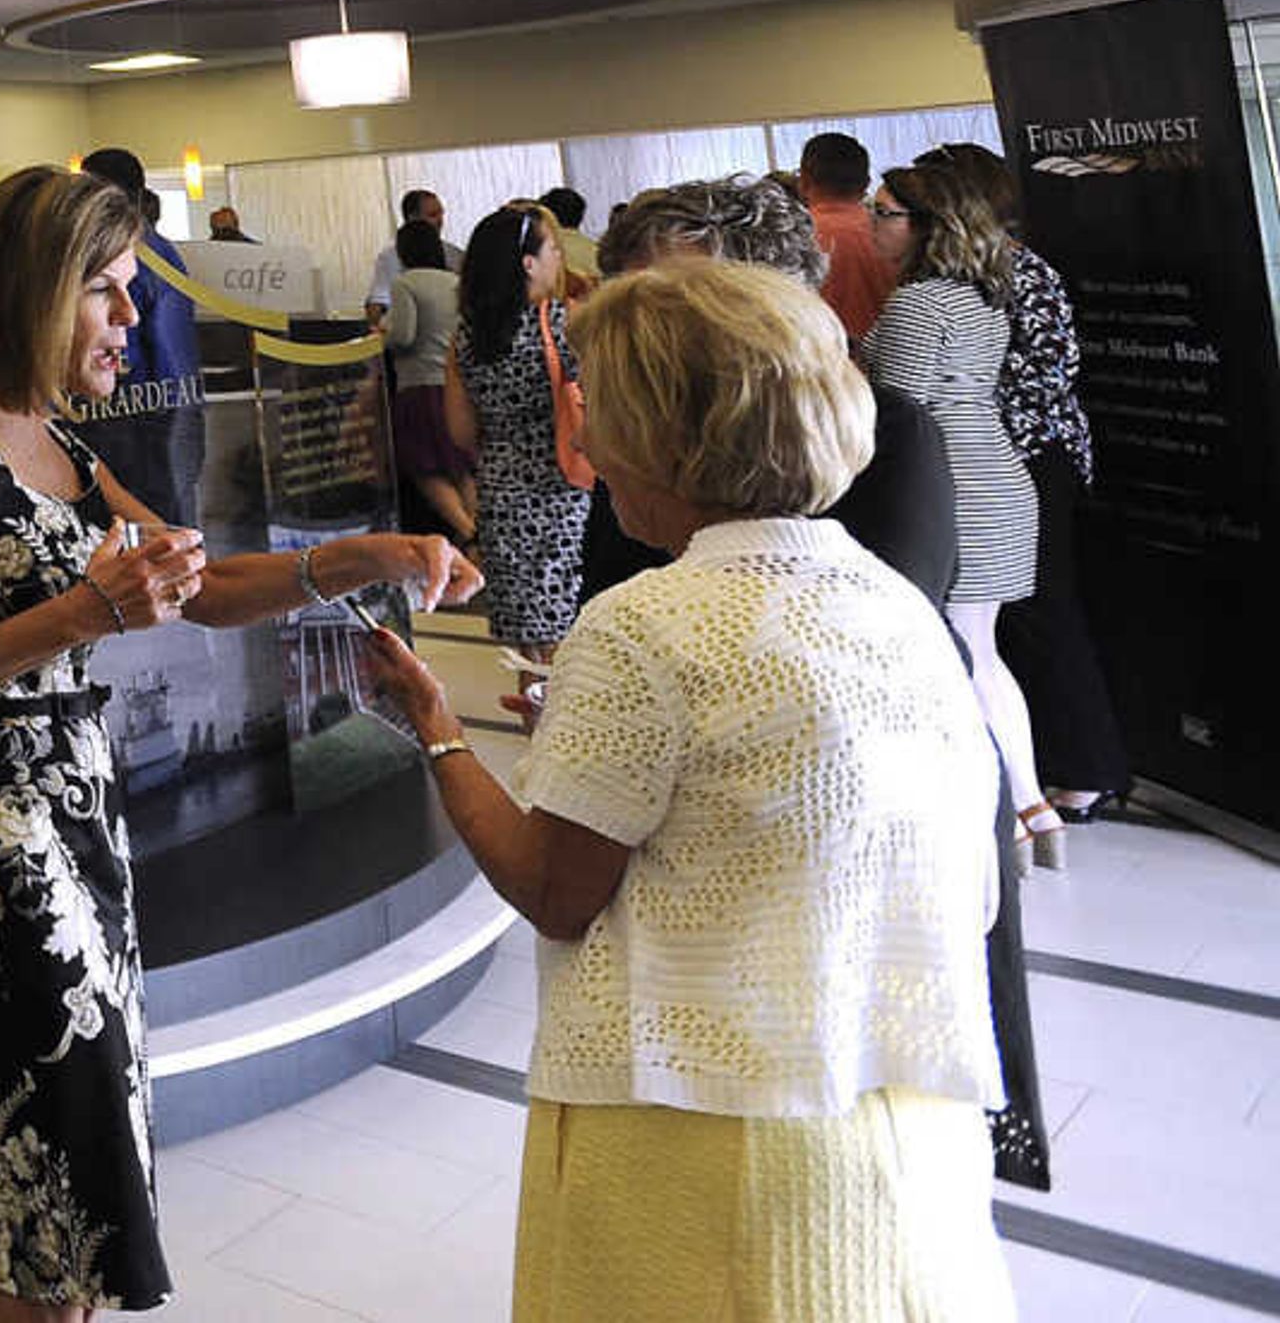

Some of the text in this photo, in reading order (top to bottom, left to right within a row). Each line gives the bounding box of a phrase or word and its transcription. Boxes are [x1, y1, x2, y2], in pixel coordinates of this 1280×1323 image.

[1026, 117, 1199, 153] FIRST MIDWEST
[223, 261, 287, 294] café
[1107, 336, 1169, 361] Midwest
[1173, 340, 1220, 365] Bank
[68, 374, 206, 423] GIRARDEAU
